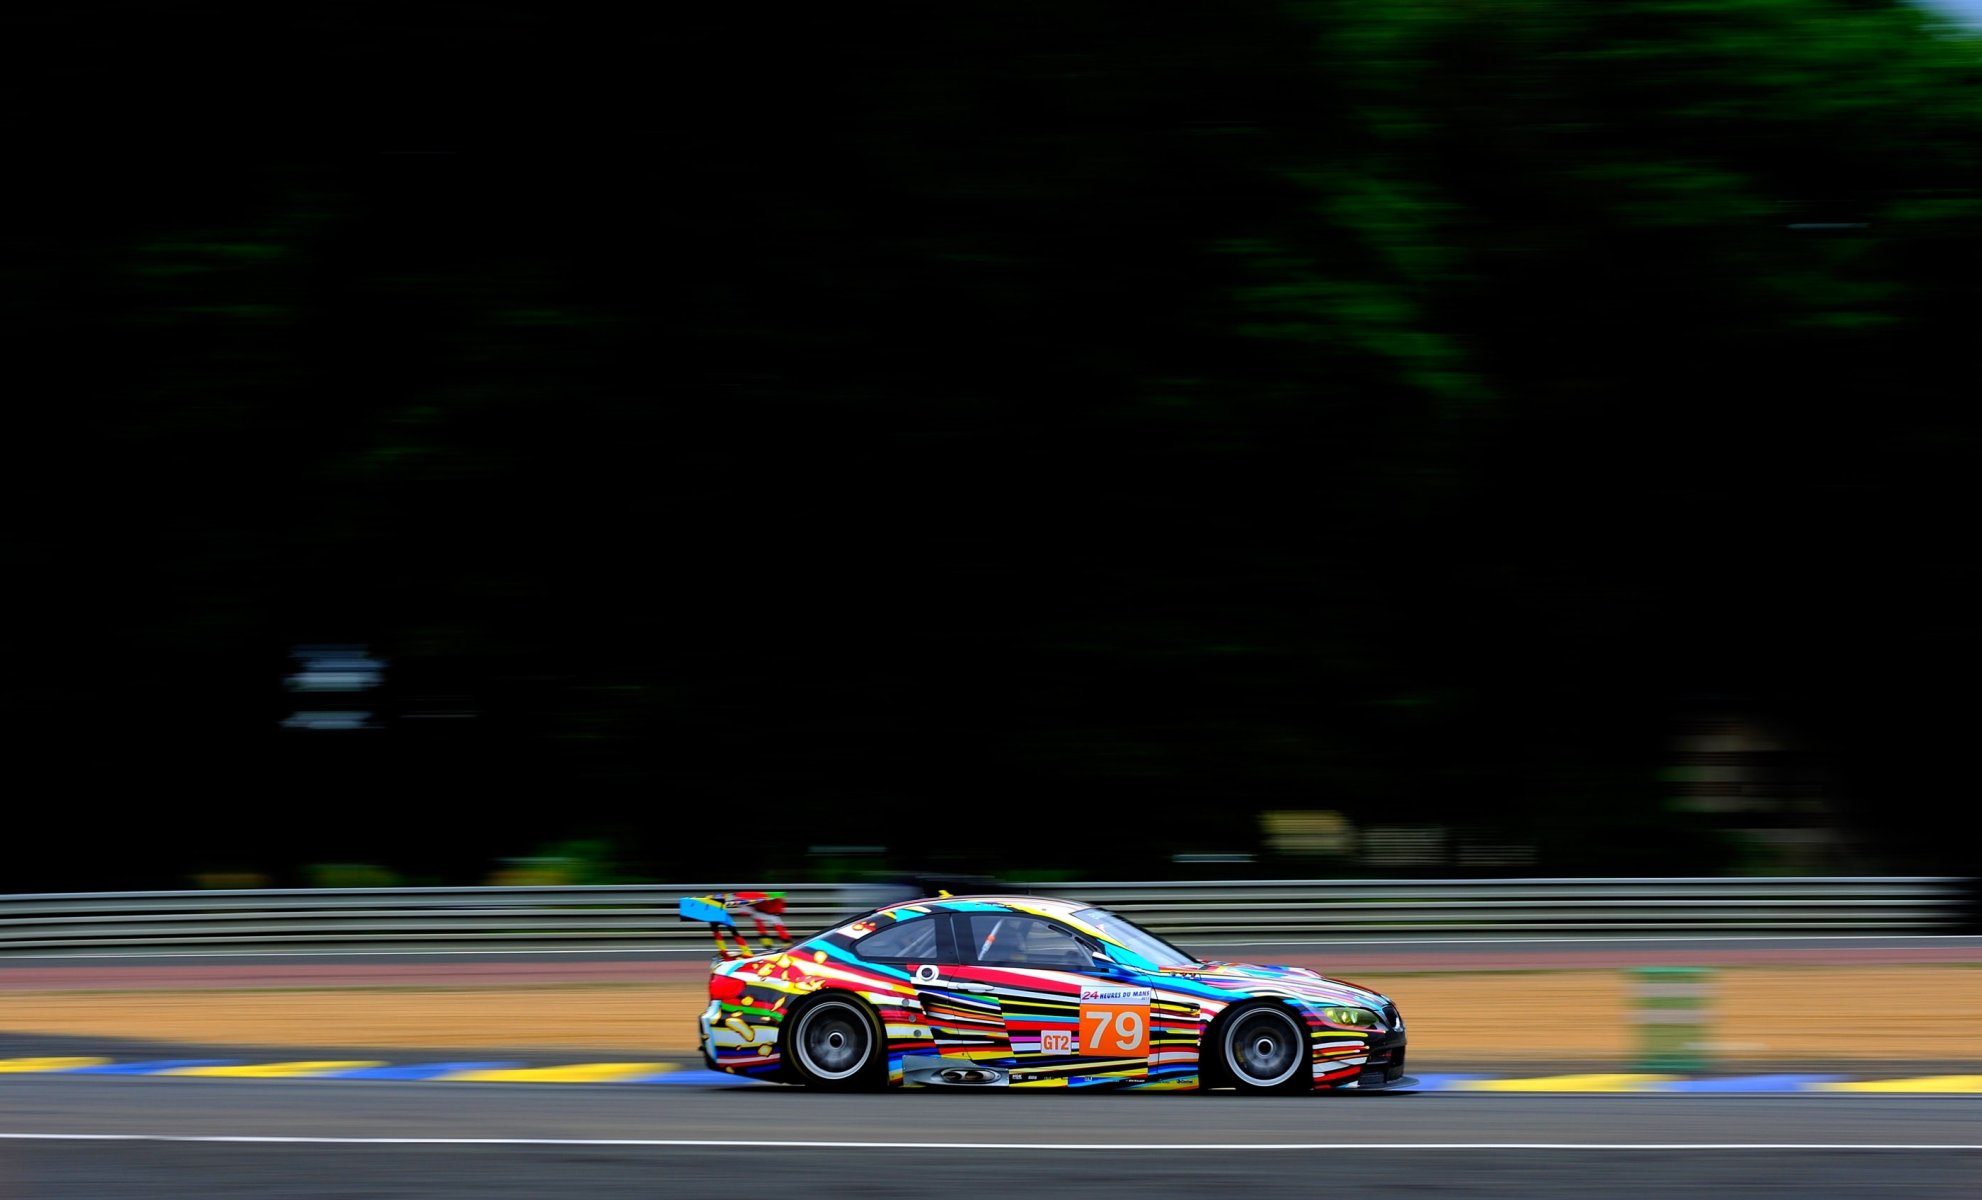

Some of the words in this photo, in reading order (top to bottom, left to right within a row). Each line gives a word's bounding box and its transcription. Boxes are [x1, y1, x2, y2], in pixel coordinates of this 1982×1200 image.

[1082, 991, 1099, 1000] 24
[1086, 1011, 1143, 1051] 79
[1043, 1035, 1069, 1050] GT2
